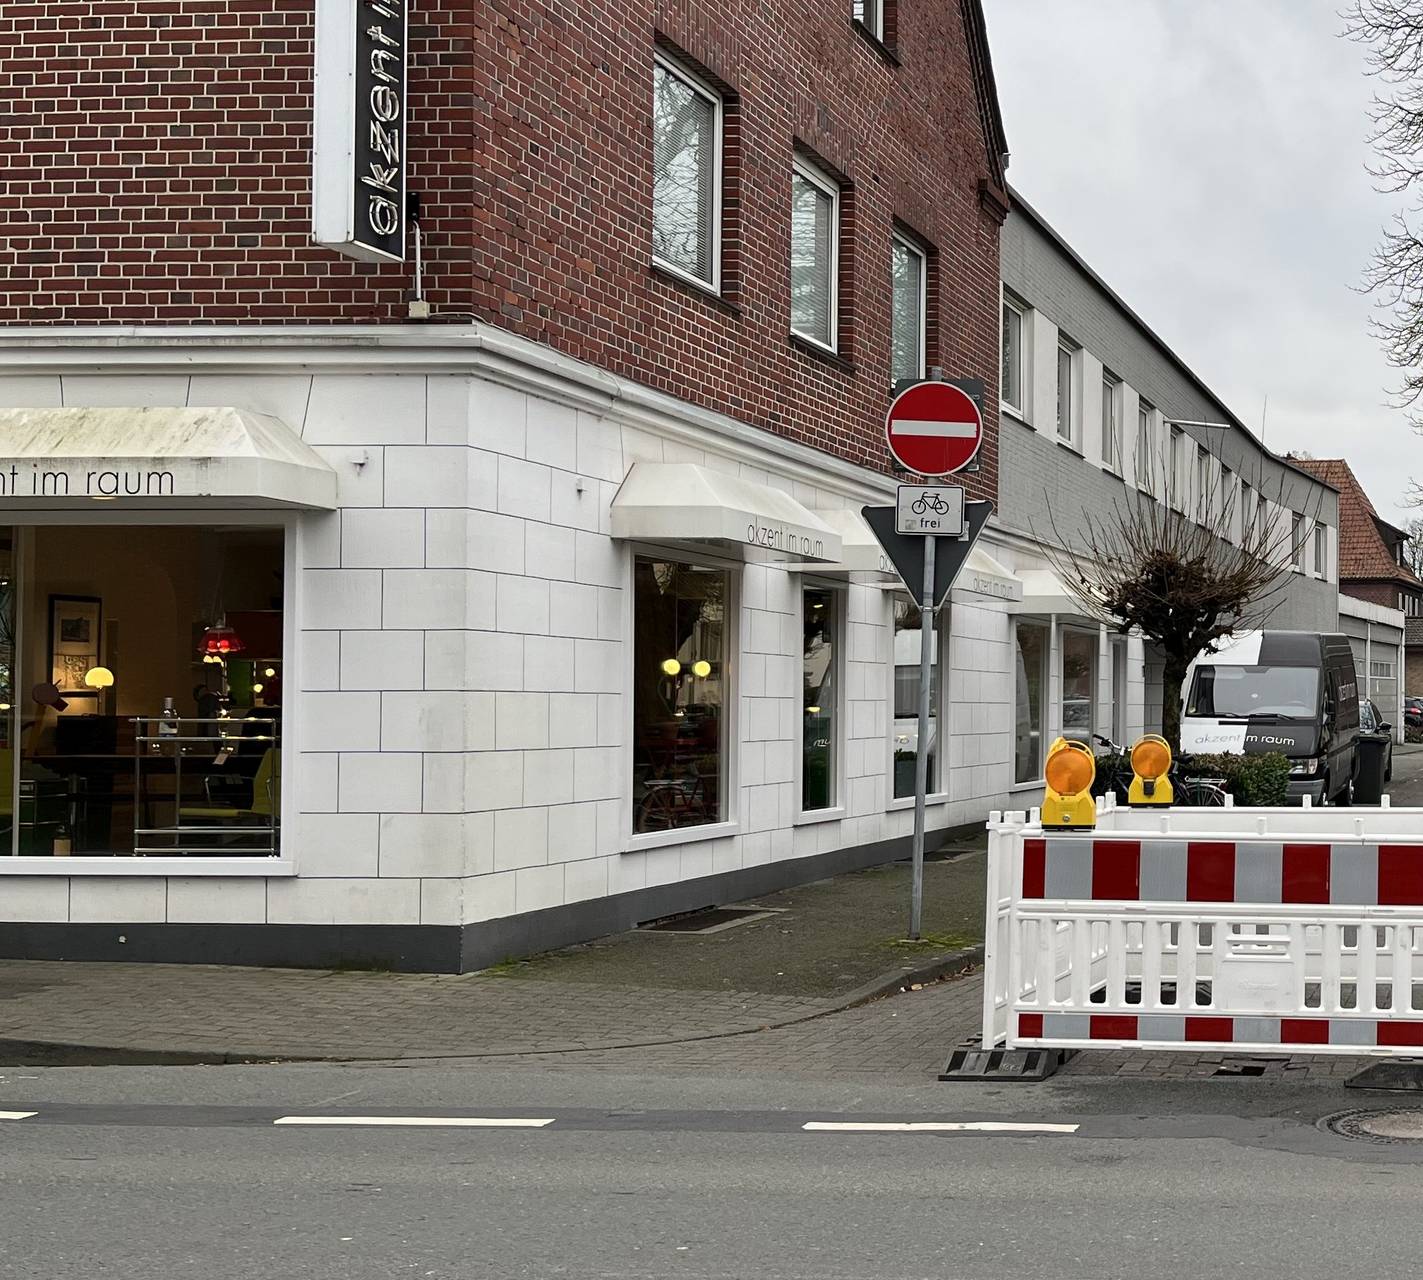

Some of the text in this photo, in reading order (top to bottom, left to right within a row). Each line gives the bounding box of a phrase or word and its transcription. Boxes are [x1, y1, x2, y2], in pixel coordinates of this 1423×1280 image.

[360, 0, 400, 235] akzent i
[33, 464, 69, 495] im
[87, 471, 174, 495] raum
[919, 517, 941, 528] frei
[1195, 733, 1240, 744] akzent
[1261, 735, 1295, 746] raum
